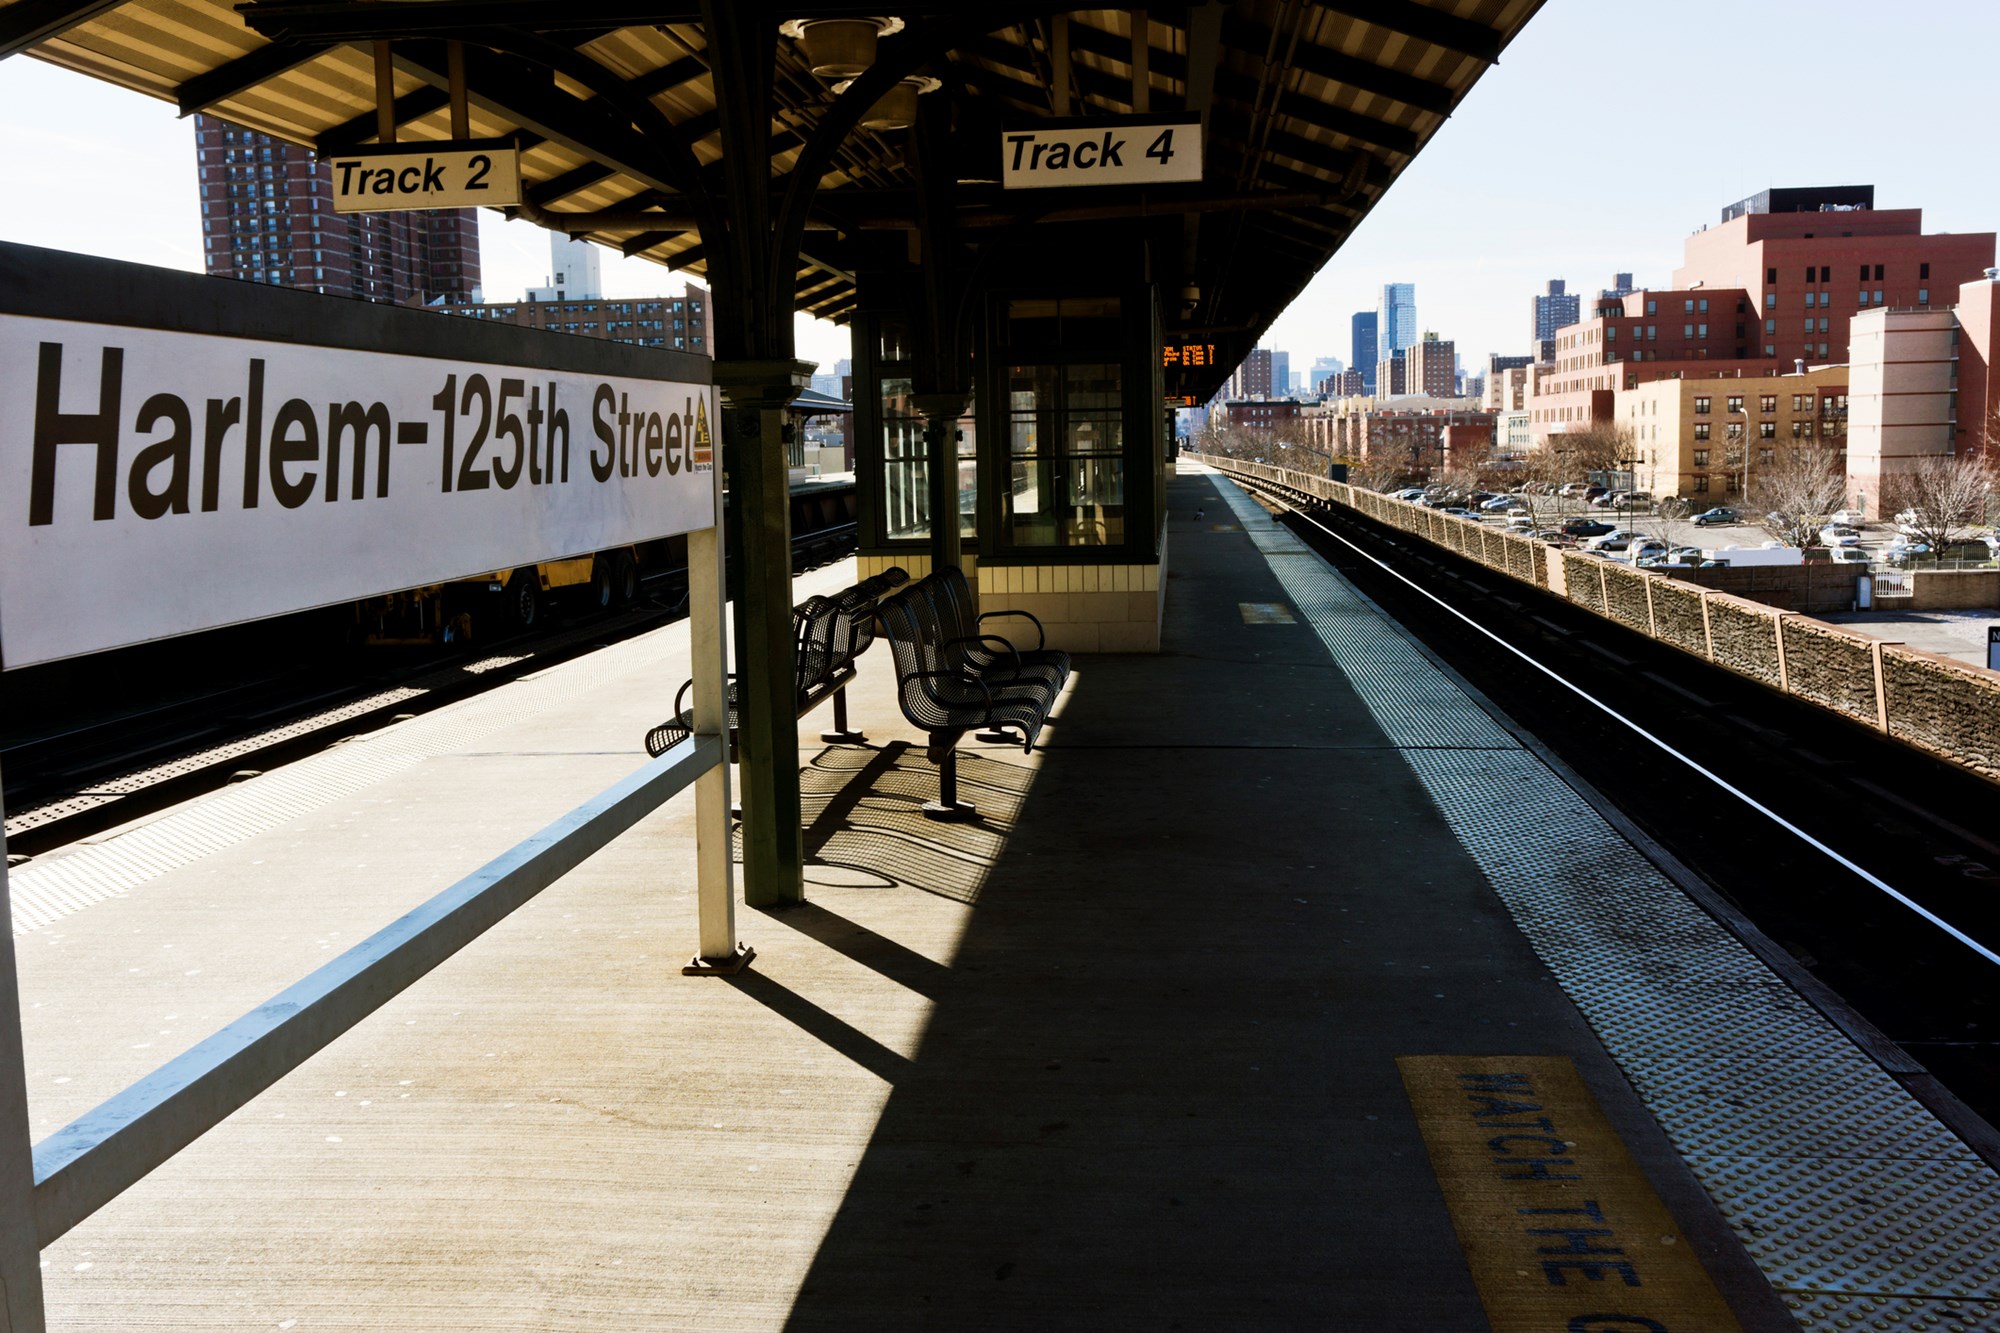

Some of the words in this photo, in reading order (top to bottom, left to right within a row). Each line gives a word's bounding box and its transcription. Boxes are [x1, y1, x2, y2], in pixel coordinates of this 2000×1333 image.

[336, 158, 446, 195] Track
[465, 155, 491, 190] 2
[1007, 131, 1126, 171] Track
[1146, 129, 1174, 165] 4
[29, 341, 570, 526] Harlem-125th
[590, 383, 693, 482] Street
[1457, 1073, 1581, 1181] WATCH
[1518, 1200, 1642, 1287] THE
